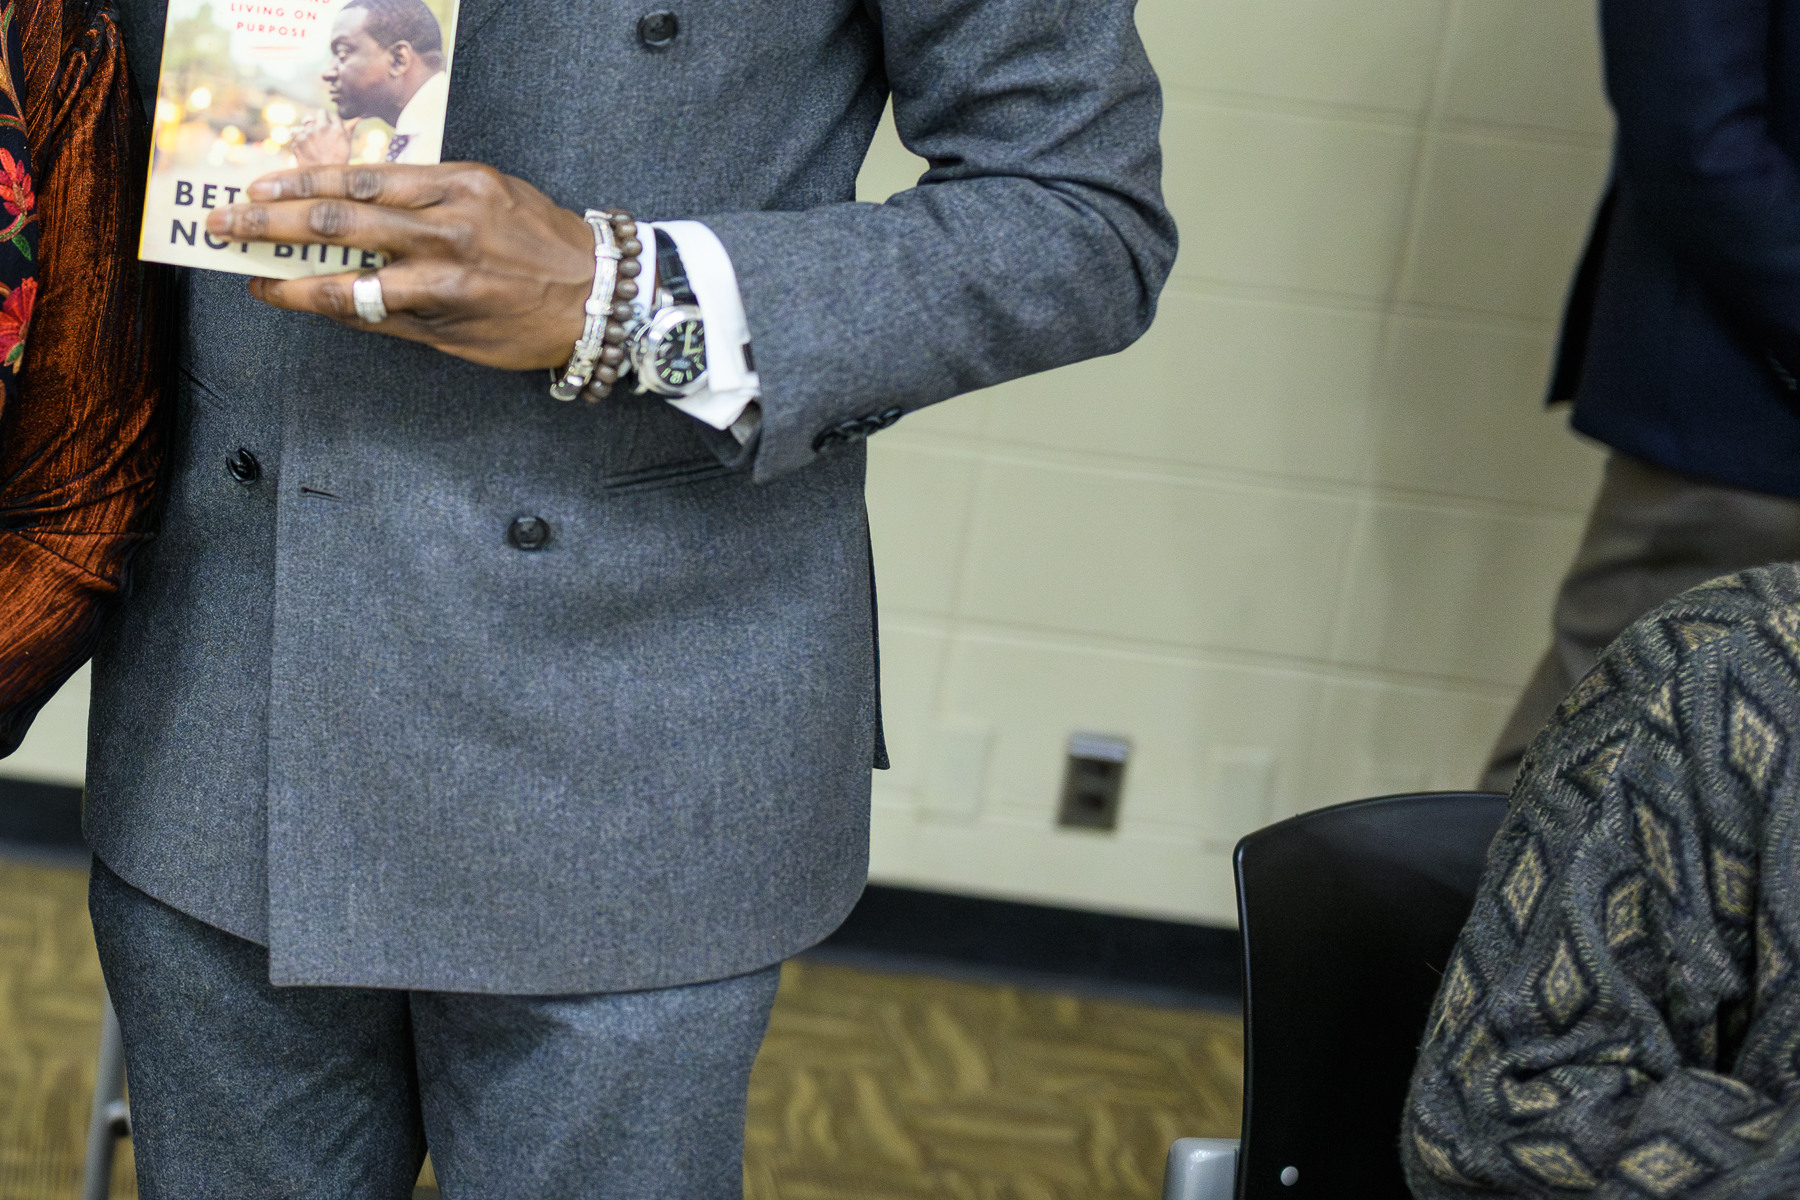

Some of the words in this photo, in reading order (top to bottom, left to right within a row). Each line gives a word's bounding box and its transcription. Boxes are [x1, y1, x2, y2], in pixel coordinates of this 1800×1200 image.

[231, 2, 285, 17] LIVING
[294, 9, 317, 21] ON
[237, 21, 306, 38] PURPOSE
[175, 180, 241, 209] BET
[274, 244, 387, 268] BITTE
